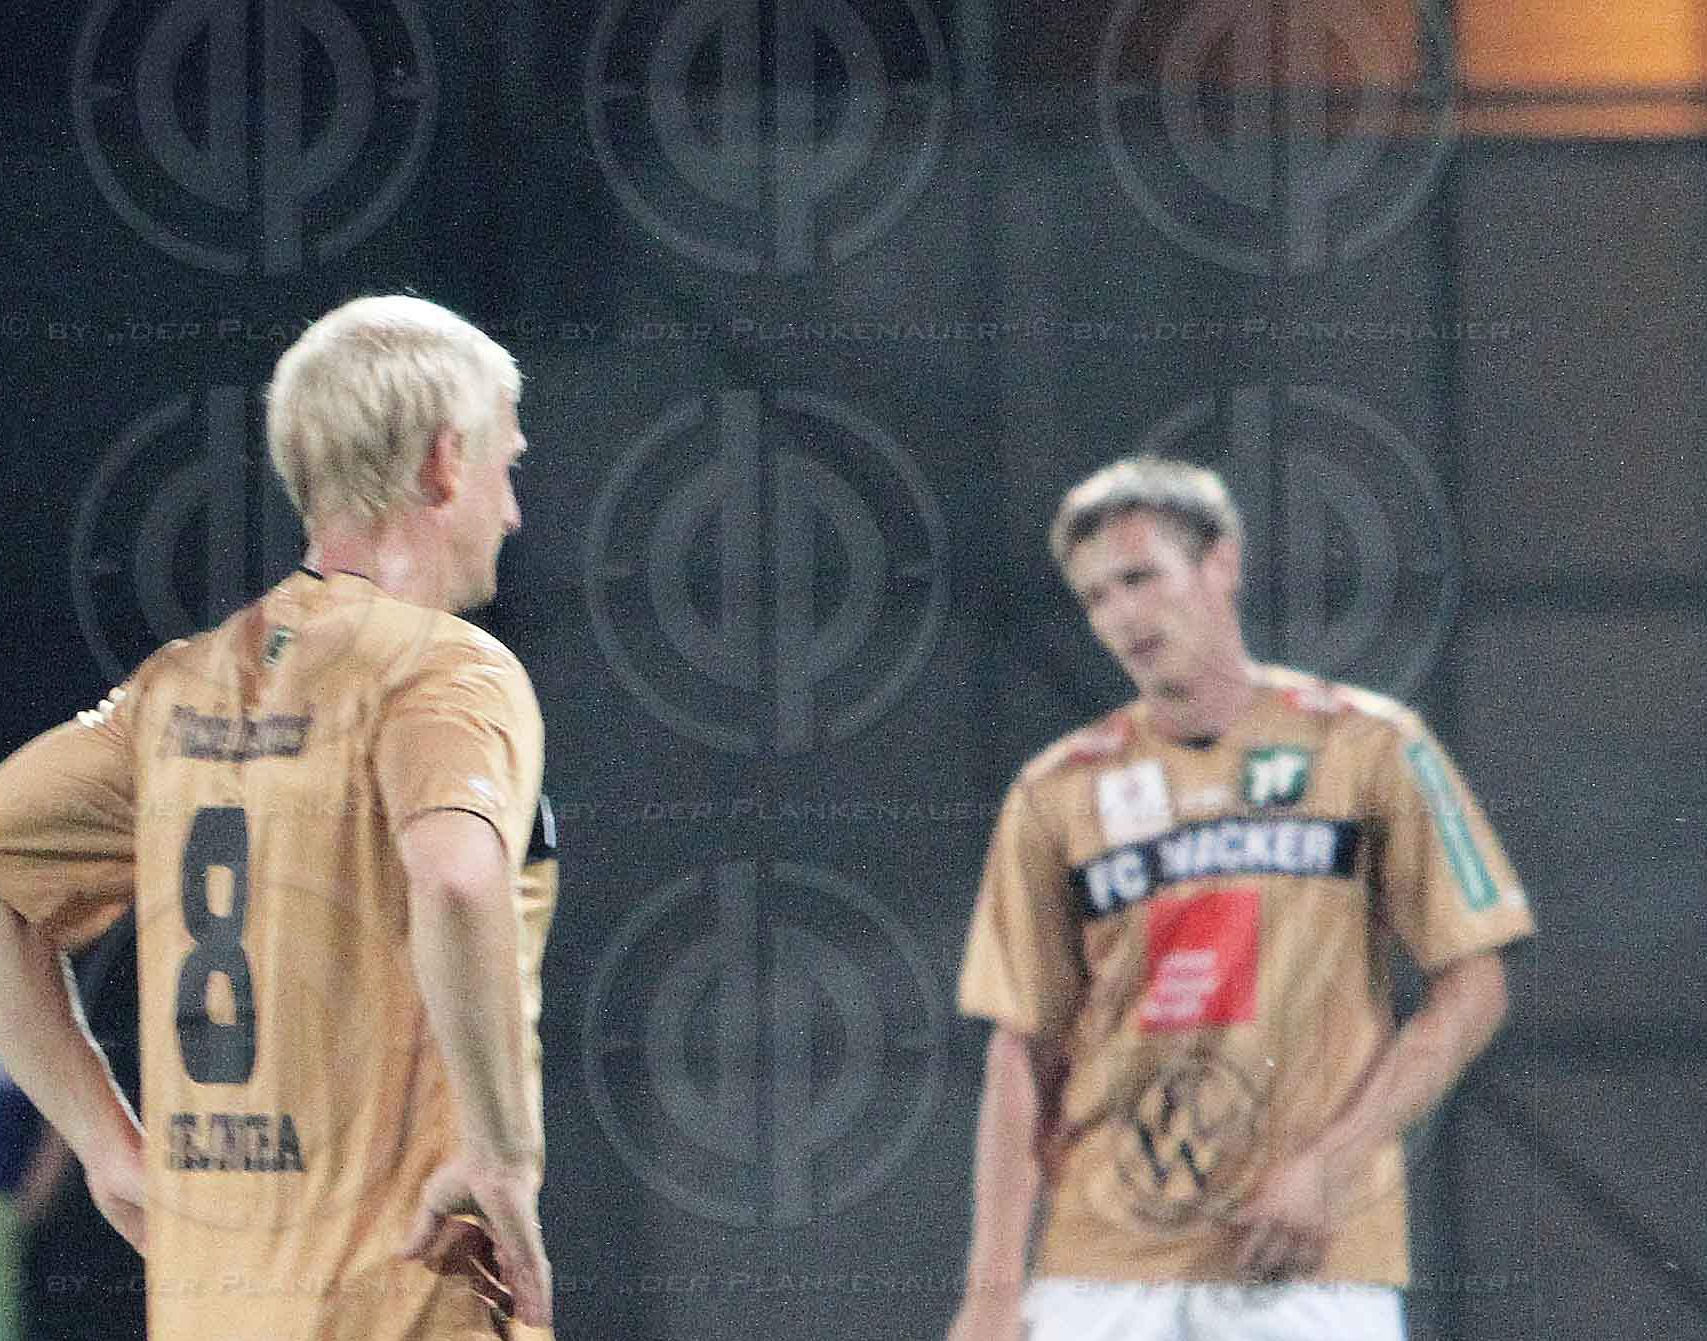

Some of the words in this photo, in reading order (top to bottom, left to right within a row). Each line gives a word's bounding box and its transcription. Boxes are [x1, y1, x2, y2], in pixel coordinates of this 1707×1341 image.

[176, 806, 258, 1083] 8
[1086, 850, 1149, 910] FC
[1157, 822, 1333, 877] WACKER
